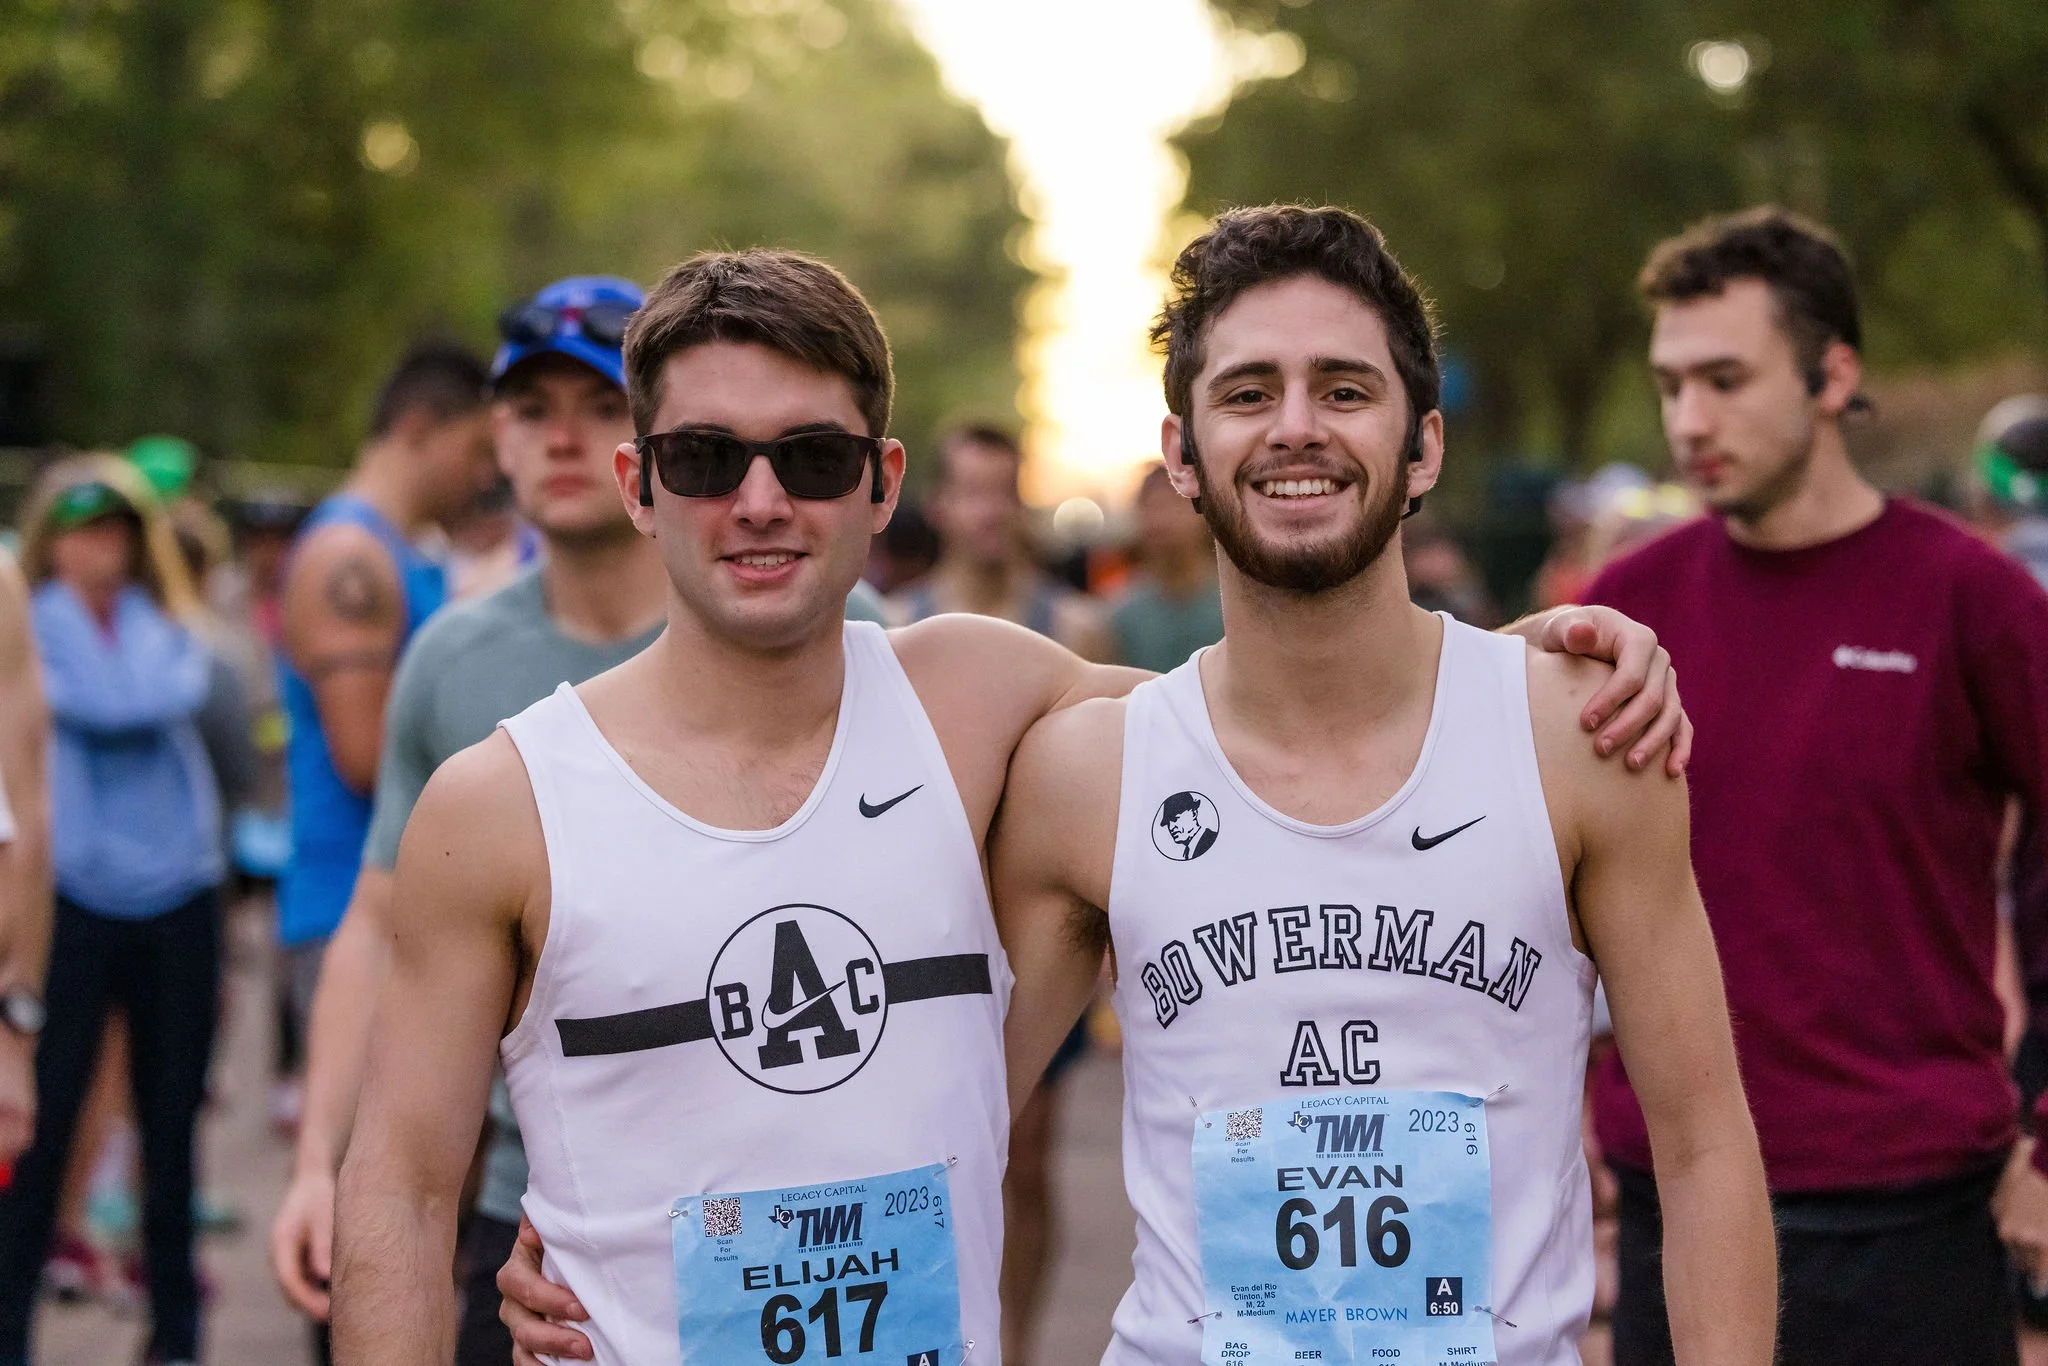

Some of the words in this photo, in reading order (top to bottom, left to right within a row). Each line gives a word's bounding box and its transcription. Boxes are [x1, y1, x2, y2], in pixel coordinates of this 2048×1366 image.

[1140, 904, 1542, 1029] BOWERMAN
[1280, 1019, 1381, 1086] AC
[1301, 1097, 1341, 1109] LEGACY
[1344, 1095, 1389, 1105] CAPITAL
[1408, 1108, 1459, 1133] 2023
[1314, 1113, 1385, 1153] TWM
[1464, 1122, 1478, 1155] 616
[1277, 1164, 1403, 1192] EVAN
[781, 1190, 821, 1202] LEGACY
[824, 1184, 867, 1197] CAPITAL
[885, 1186, 929, 1216] 2023
[932, 1195, 944, 1229] 617
[796, 1202, 864, 1248] TWM
[1275, 1195, 1411, 1271] 616
[742, 1248, 899, 1291] ELIJAH
[1231, 1285, 1250, 1293] Evan
[1251, 1283, 1263, 1292] del
[1264, 1283, 1277, 1291] Rio
[1437, 1278, 1453, 1296] A
[1233, 1292, 1263, 1301] Clinton,
[1256, 1300, 1266, 1308] 22
[1236, 1309, 1276, 1318] M-Medium
[1285, 1308, 1337, 1324] MAYER
[1346, 1307, 1408, 1321] BROWN
[1429, 1301, 1459, 1315] 6:50
[760, 1281, 888, 1365] 617
[1221, 1350, 1251, 1358] DROP
[1225, 1341, 1248, 1350] BAG
[1372, 1348, 1401, 1358] FOOD
[1446, 1346, 1478, 1356] SHIRT
[918, 1353, 931, 1366] A
[1294, 1351, 1322, 1360] BEER
